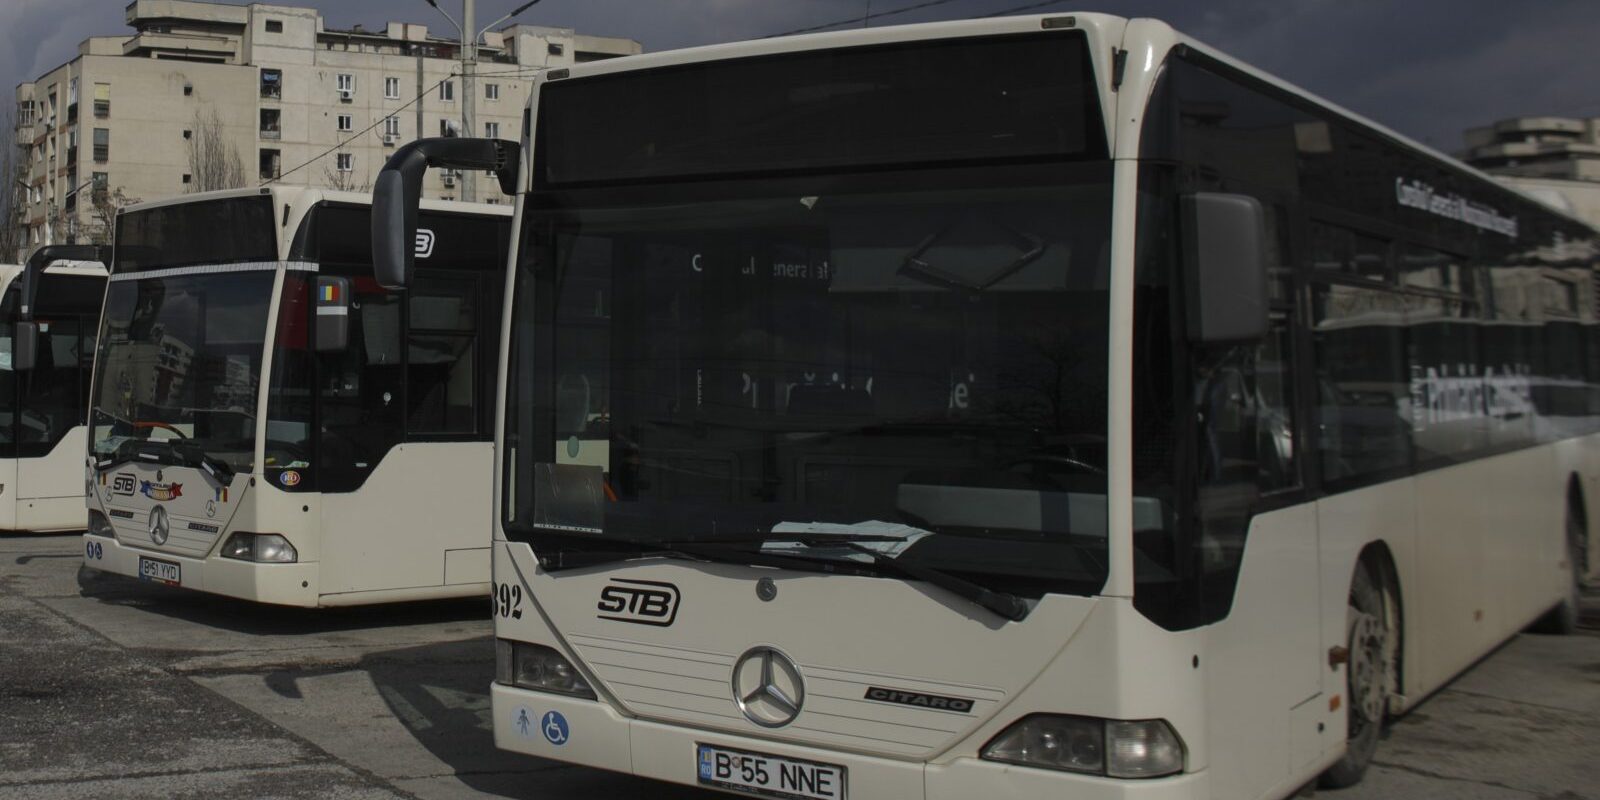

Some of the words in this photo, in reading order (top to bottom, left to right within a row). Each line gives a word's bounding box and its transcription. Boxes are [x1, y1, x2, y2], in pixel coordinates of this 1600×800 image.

[113, 476, 135, 491] STB
[144, 560, 150, 574] B
[151, 562, 159, 576] 51
[597, 585, 672, 617] STB
[870, 689, 969, 710] CITARO
[715, 753, 731, 778] B
[741, 757, 769, 785] 55
[780, 763, 834, 797] NNE
